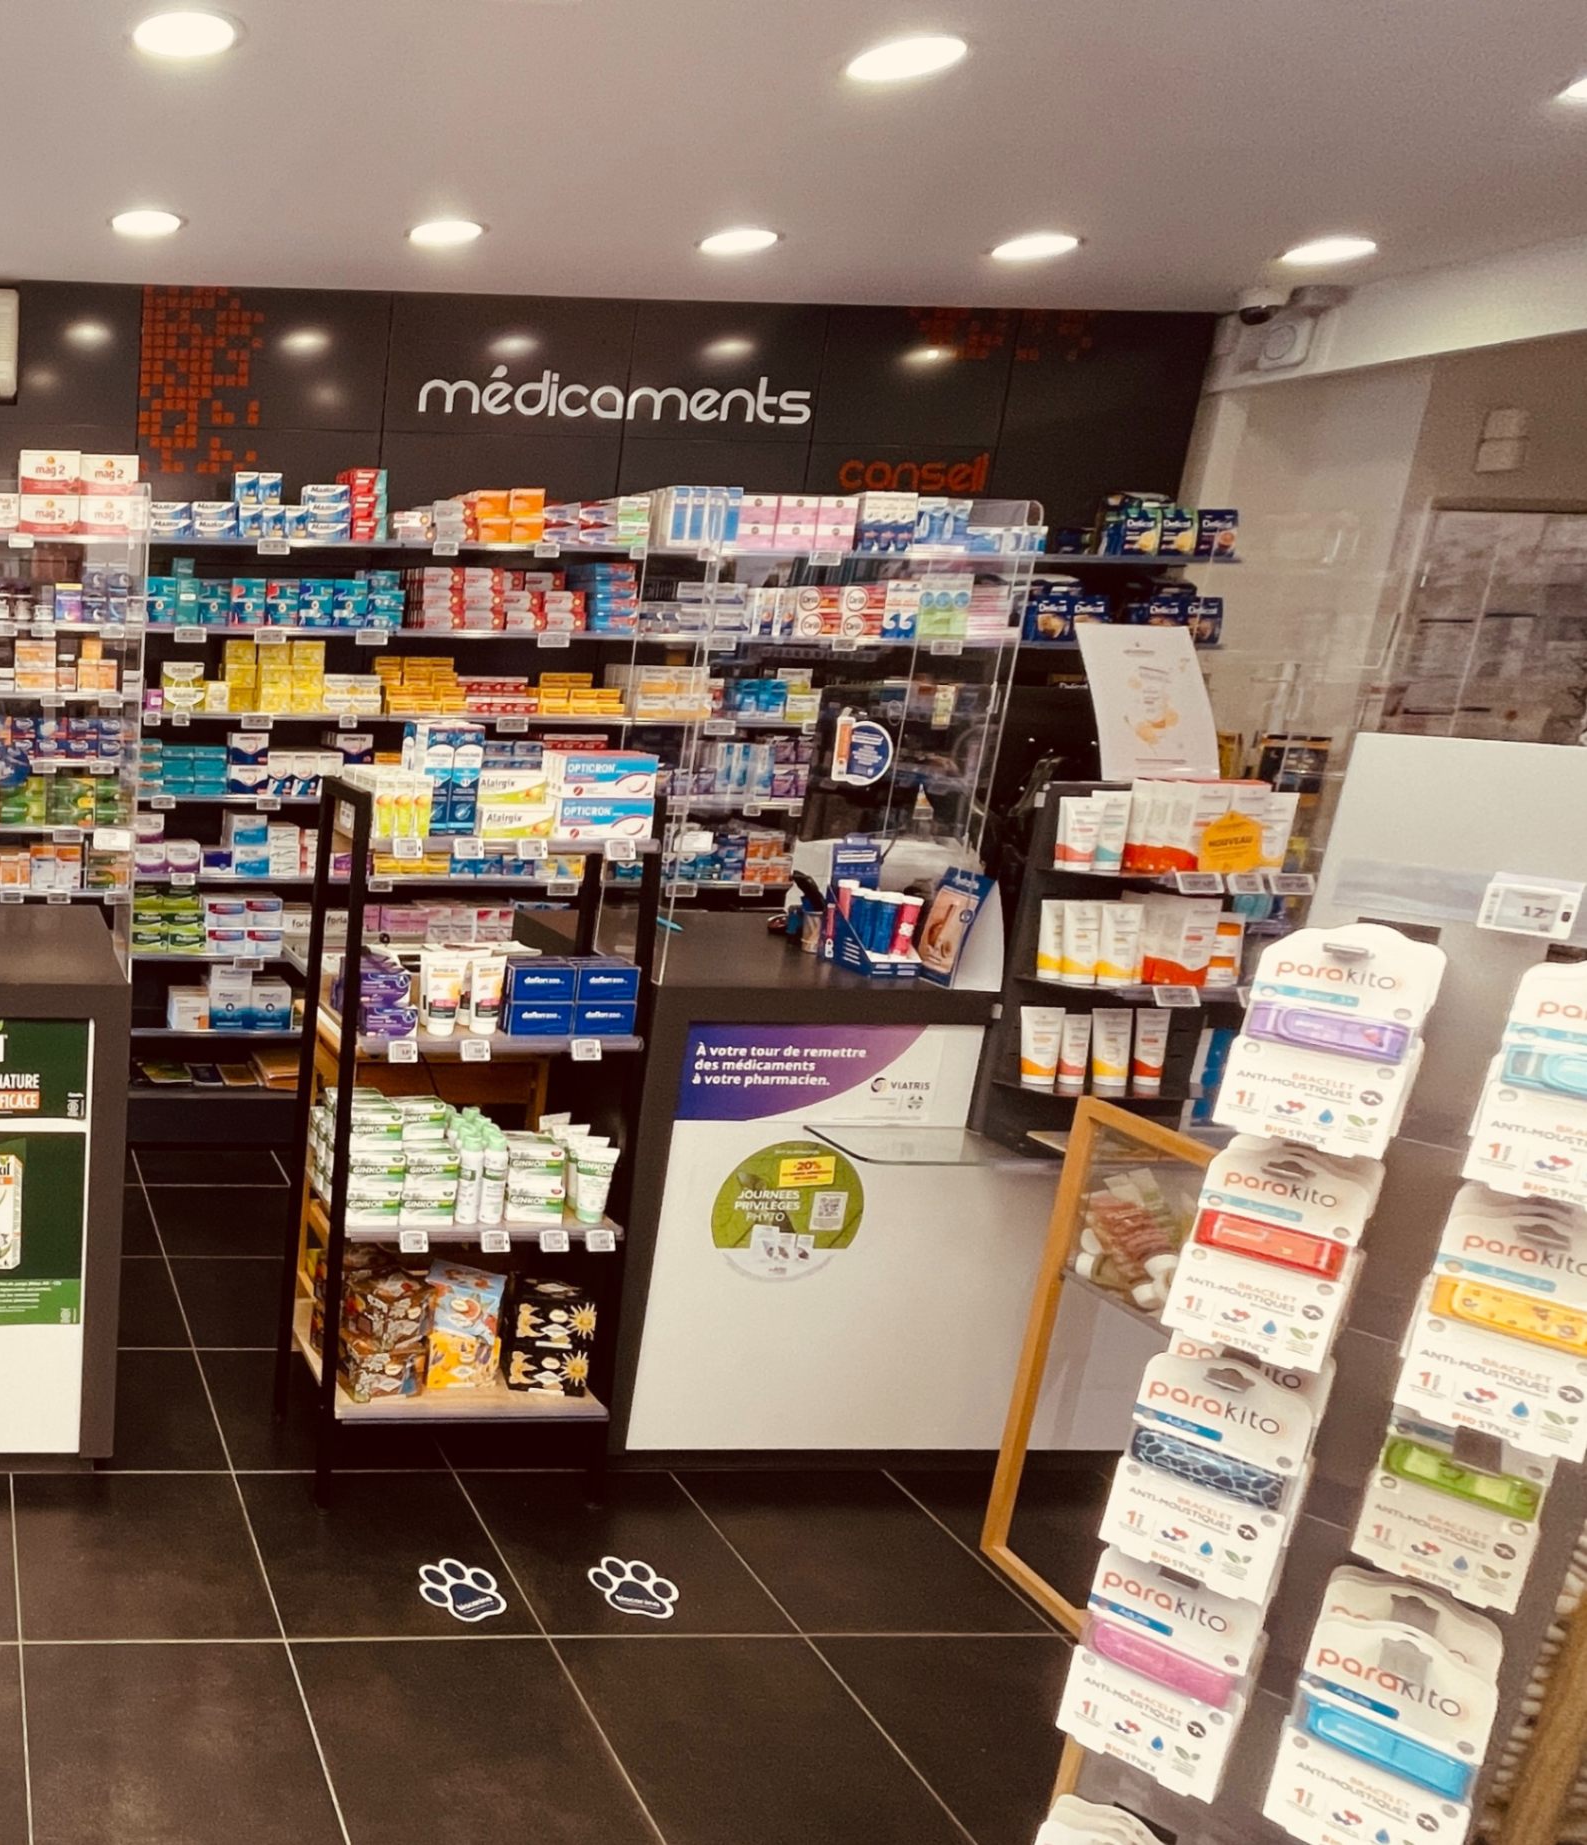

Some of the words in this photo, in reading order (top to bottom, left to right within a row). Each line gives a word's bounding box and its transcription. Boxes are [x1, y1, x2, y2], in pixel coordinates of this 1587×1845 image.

[417, 365, 812, 424] médicaments
[35, 465, 57, 477] mag
[58, 465, 66, 475] 2
[94, 470, 116, 481] mag
[117, 469, 125, 478] 2
[837, 452, 991, 493] conseil
[35, 510, 57, 521] mag
[58, 509, 66, 518] 2
[94, 510, 115, 522] mag
[117, 510, 125, 519] 2
[567, 763, 617, 773] OPTICRON
[564, 806, 613, 816] OPTICRON
[327, 915, 348, 925] forla
[1276, 961, 1396, 990] parakito
[696, 1042, 707, 1057] À
[710, 1047, 747, 1057] votre
[750, 1046, 781, 1057] tour
[783, 1046, 800, 1057] de
[803, 1046, 867, 1058] remettre
[694, 1059, 719, 1071] des
[722, 1059, 815, 1071] médicaments
[692, 1073, 702, 1085] à
[705, 1075, 742, 1085] votre
[744, 1074, 830, 1088] pharmacien.
[891, 1081, 931, 1091] VIATRIS
[1236, 1070, 1352, 1099] ANTI-MOUSTIQUES
[1292, 1072, 1355, 1089] BRACELET
[1224, 1171, 1337, 1208] parakito
[1186, 1275, 1295, 1313] ANTI-MOUSTIQUES
[1237, 1281, 1297, 1302] BRACELET
[1419, 1349, 1551, 1394] ANTI-MOUSTIQUES
[1481, 1357, 1552, 1383] BRACELET
[1148, 1380, 1280, 1434] parakito
[1129, 1486, 1232, 1531] ANTI-MOUSTIQUES
[1177, 1495, 1233, 1521] BRACELET
[1102, 1570, 1227, 1633] parakito
[1317, 1648, 1462, 1717] parakito
[1084, 1676, 1181, 1727] ANTI-MOUSTIQUES
[1130, 1689, 1183, 1718] BRACELET
[1297, 1761, 1410, 1819] ANTI-MOUSTIQUES
